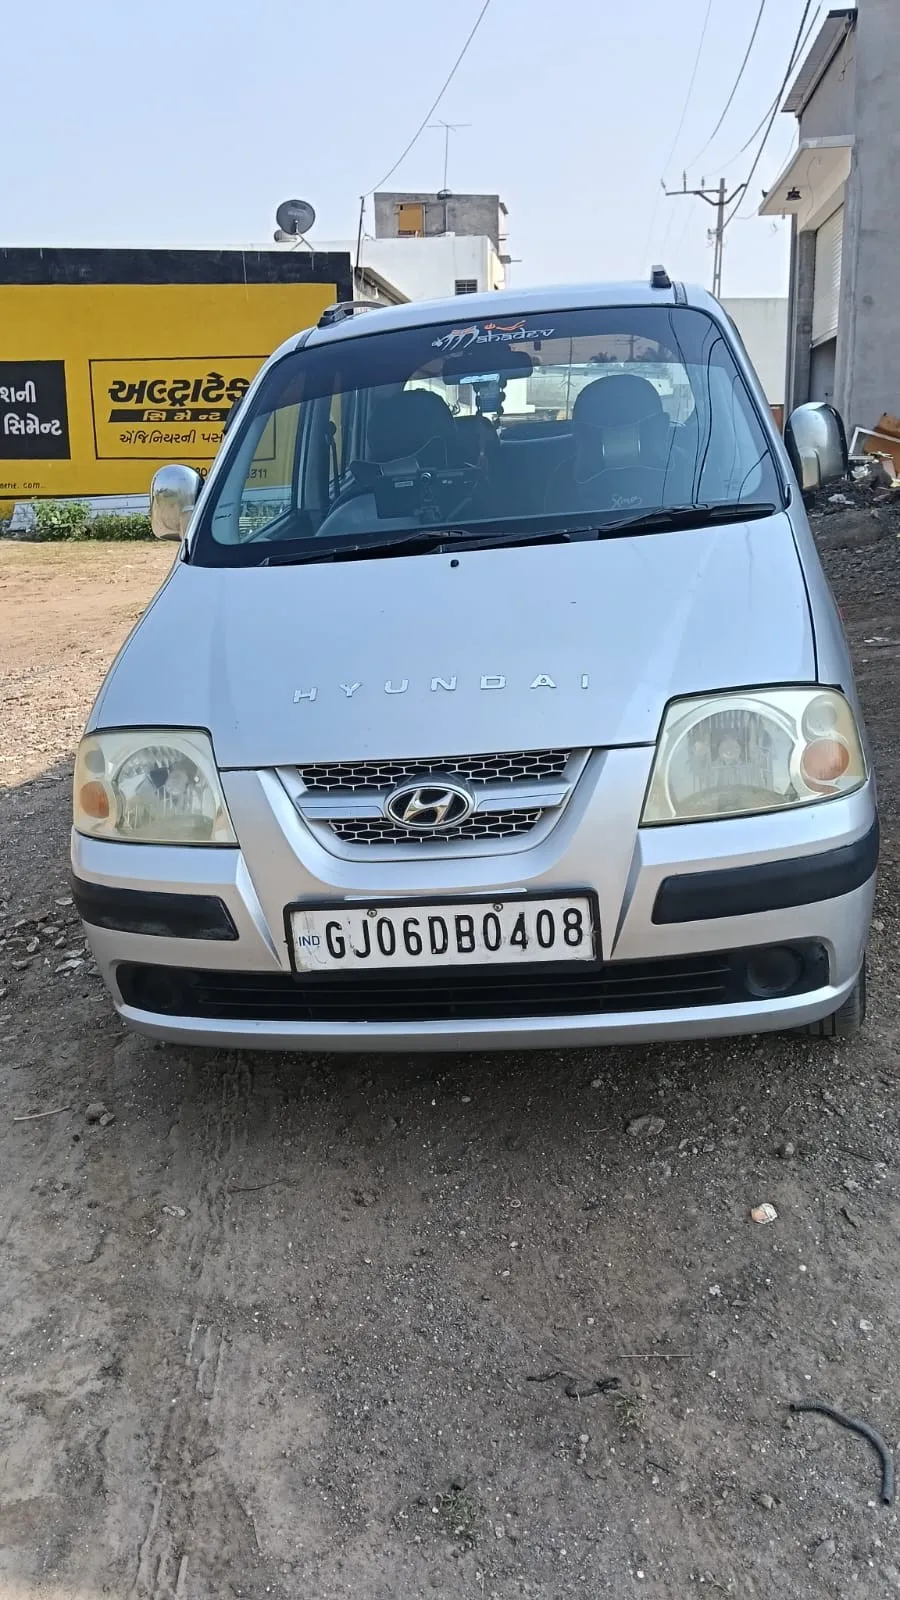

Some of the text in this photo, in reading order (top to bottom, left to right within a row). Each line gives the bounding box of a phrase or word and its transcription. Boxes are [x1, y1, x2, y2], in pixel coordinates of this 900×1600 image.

[4, 412, 63, 436] સિમેન્ટ
[292, 673, 591, 703] HYUNDAI
[299, 907, 584, 959] IND GJ06DB0408
